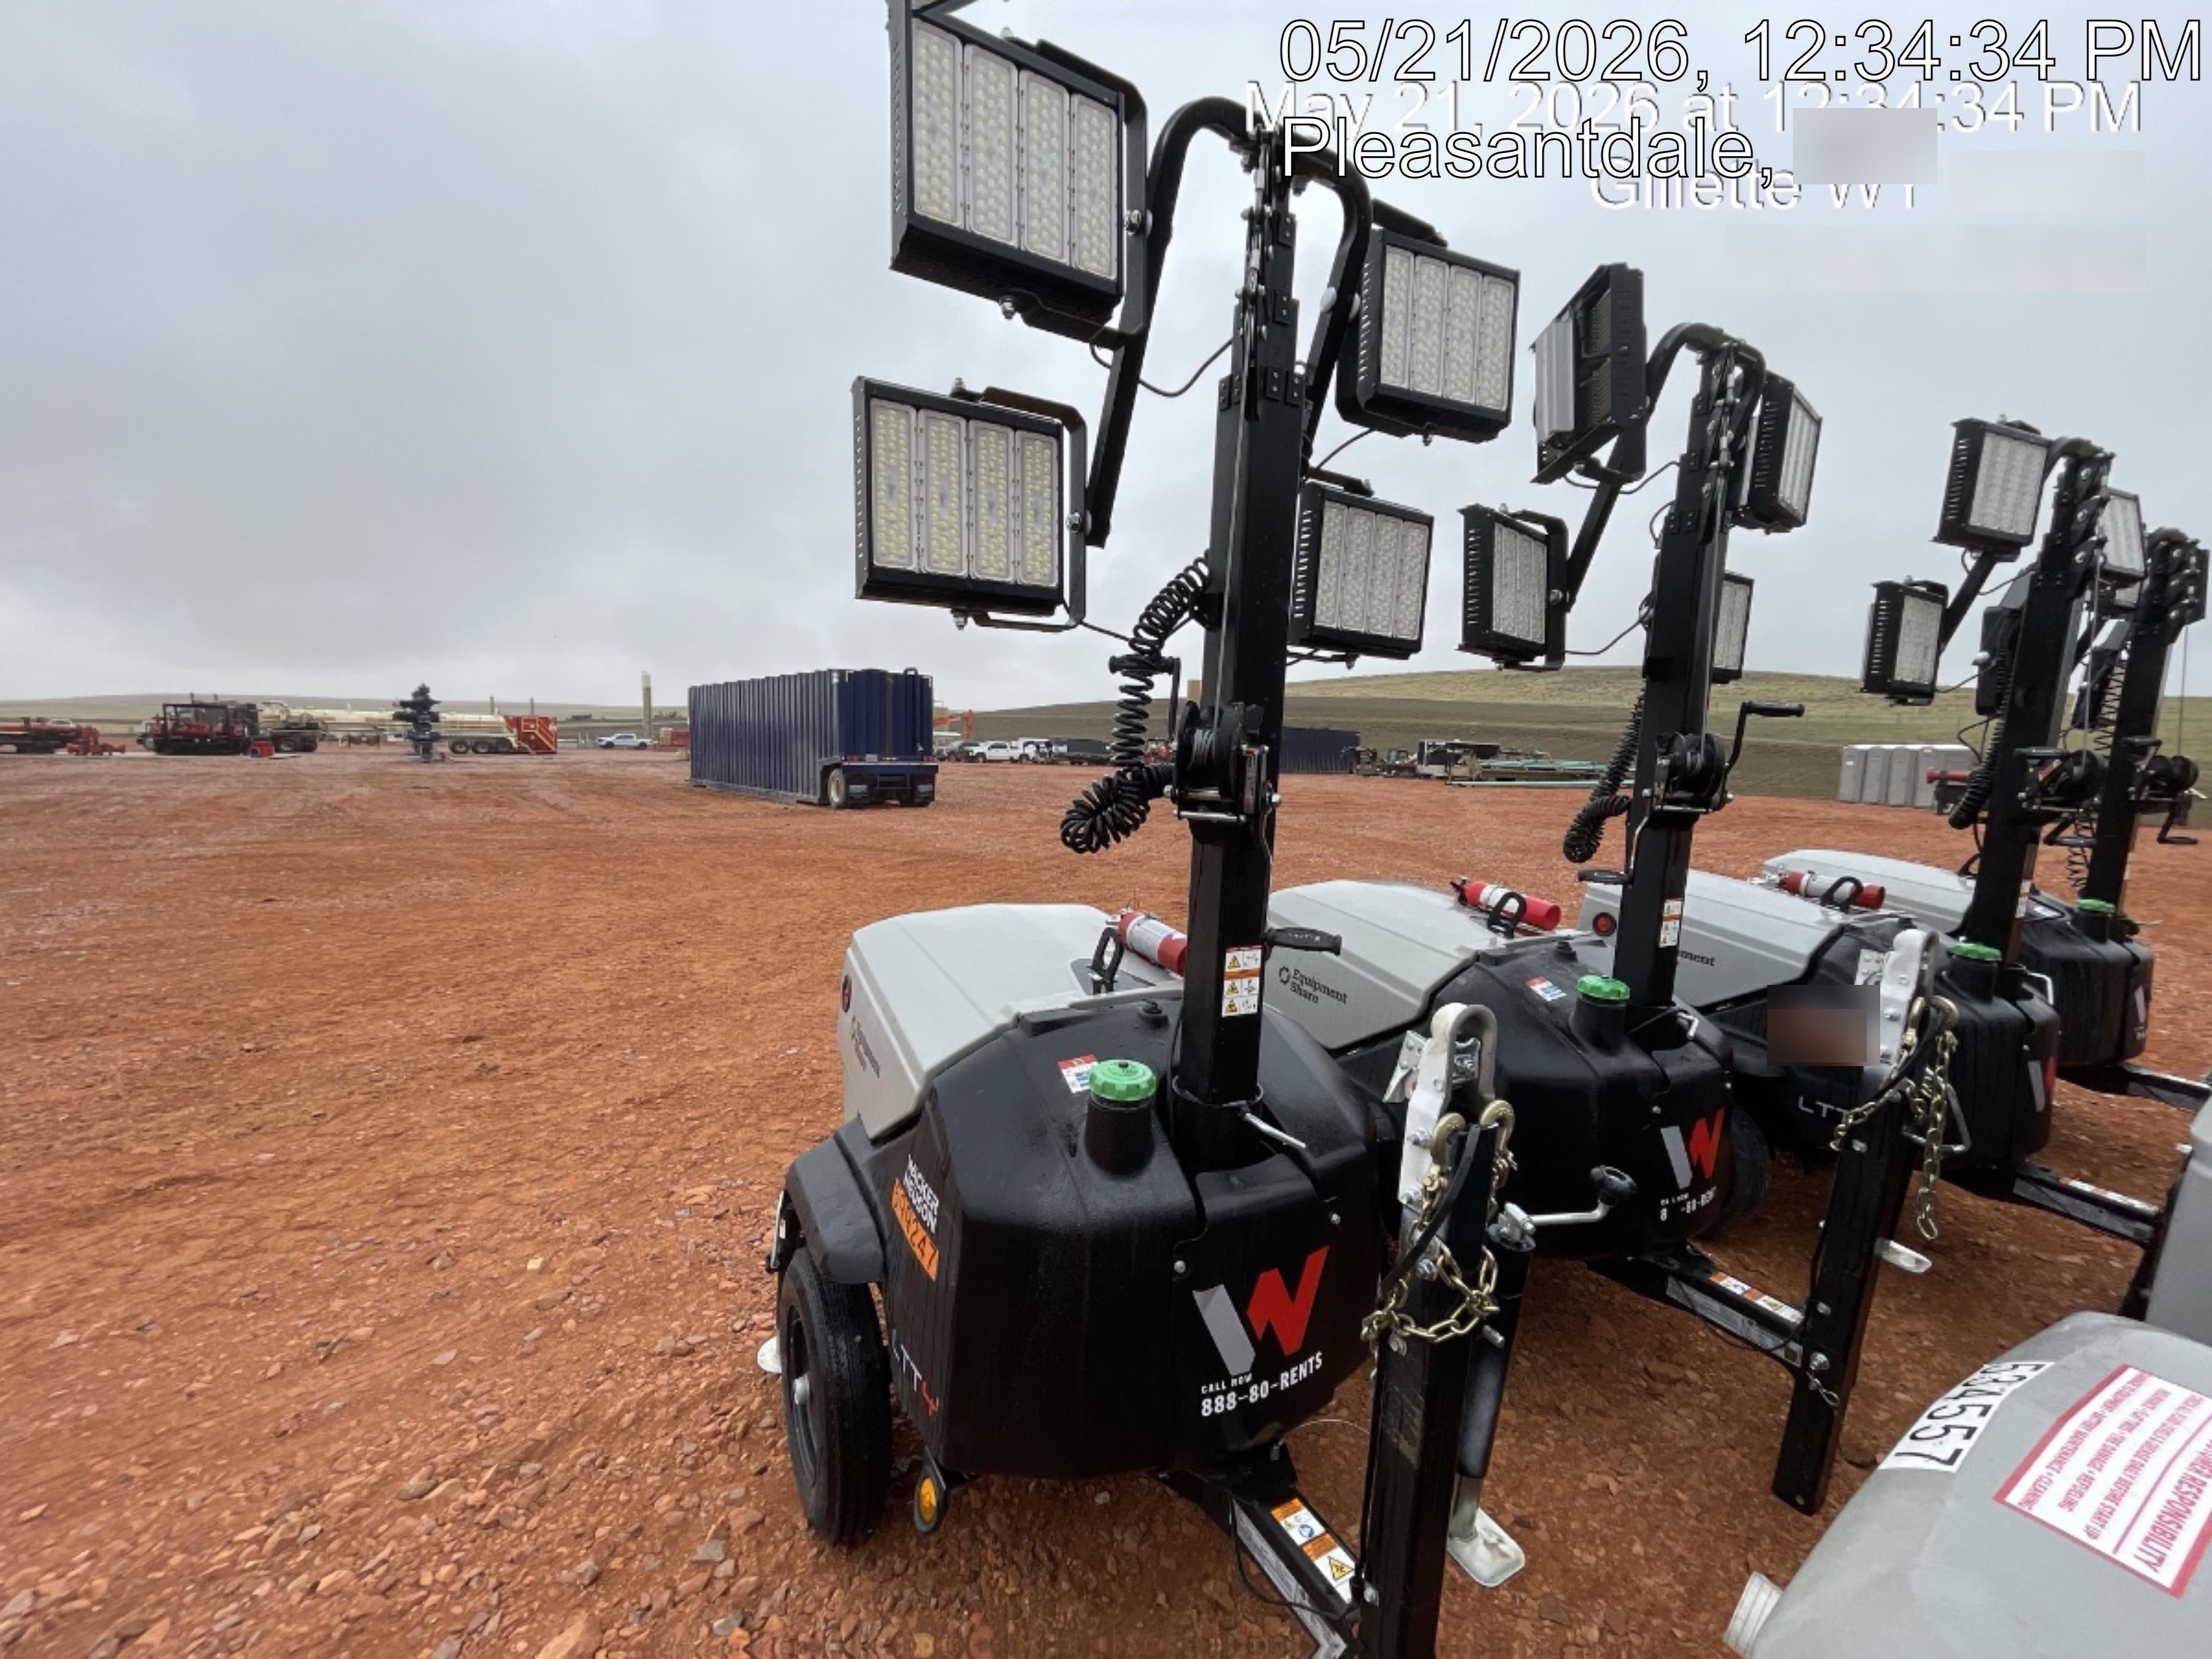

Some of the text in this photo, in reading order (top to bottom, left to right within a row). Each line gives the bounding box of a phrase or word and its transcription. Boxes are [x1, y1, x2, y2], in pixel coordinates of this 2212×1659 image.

[1292, 968, 1349, 1005] Equipment
[1201, 1372, 1253, 1394] CALL NOW
[1201, 1350, 1323, 1417] 888-80-RENTS
[2133, 1472, 2207, 1573] RESPONSIBILITY
